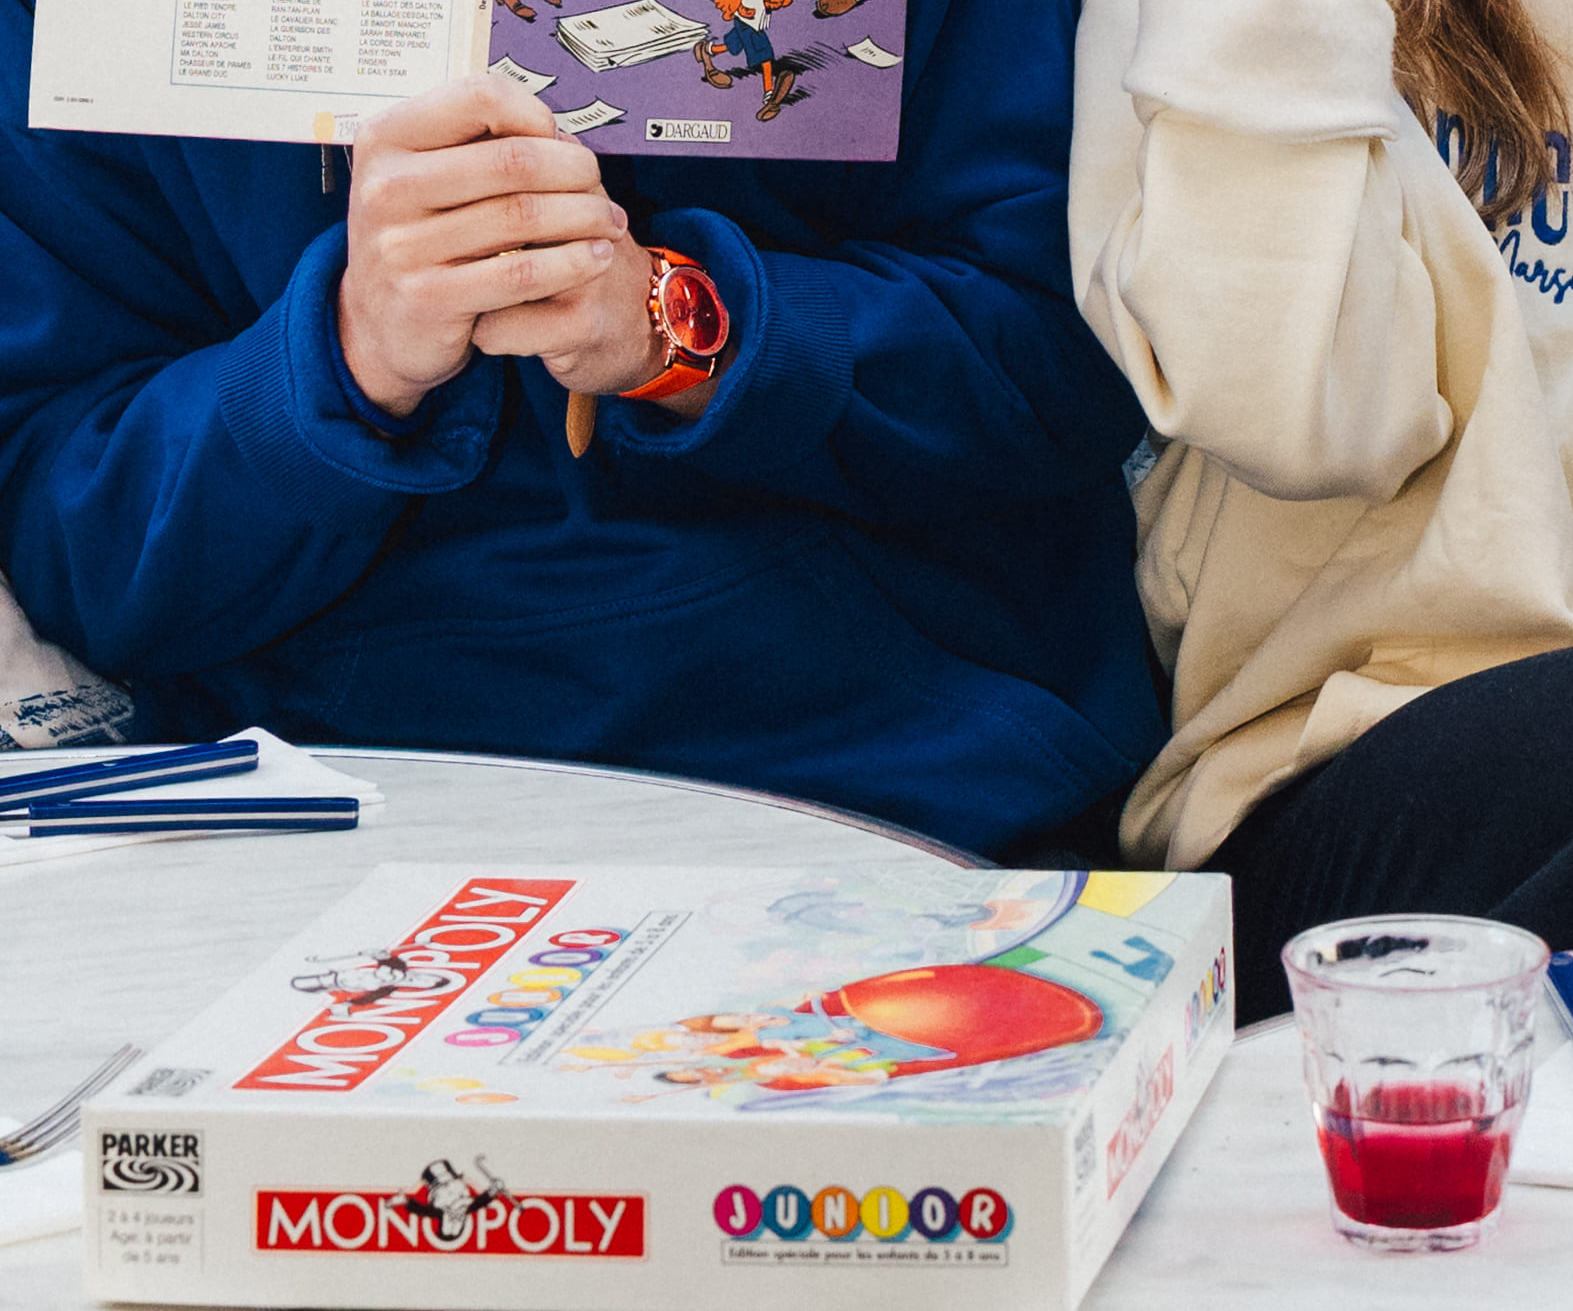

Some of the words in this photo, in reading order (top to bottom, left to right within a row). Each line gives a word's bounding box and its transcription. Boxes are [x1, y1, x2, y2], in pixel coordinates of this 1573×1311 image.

[665, 123, 728, 140] DARGAUD
[102, 1133, 199, 1158] PARKER
[268, 1193, 626, 1253] MONOPOLY
[722, 1189, 1004, 1235] JUNIOR
